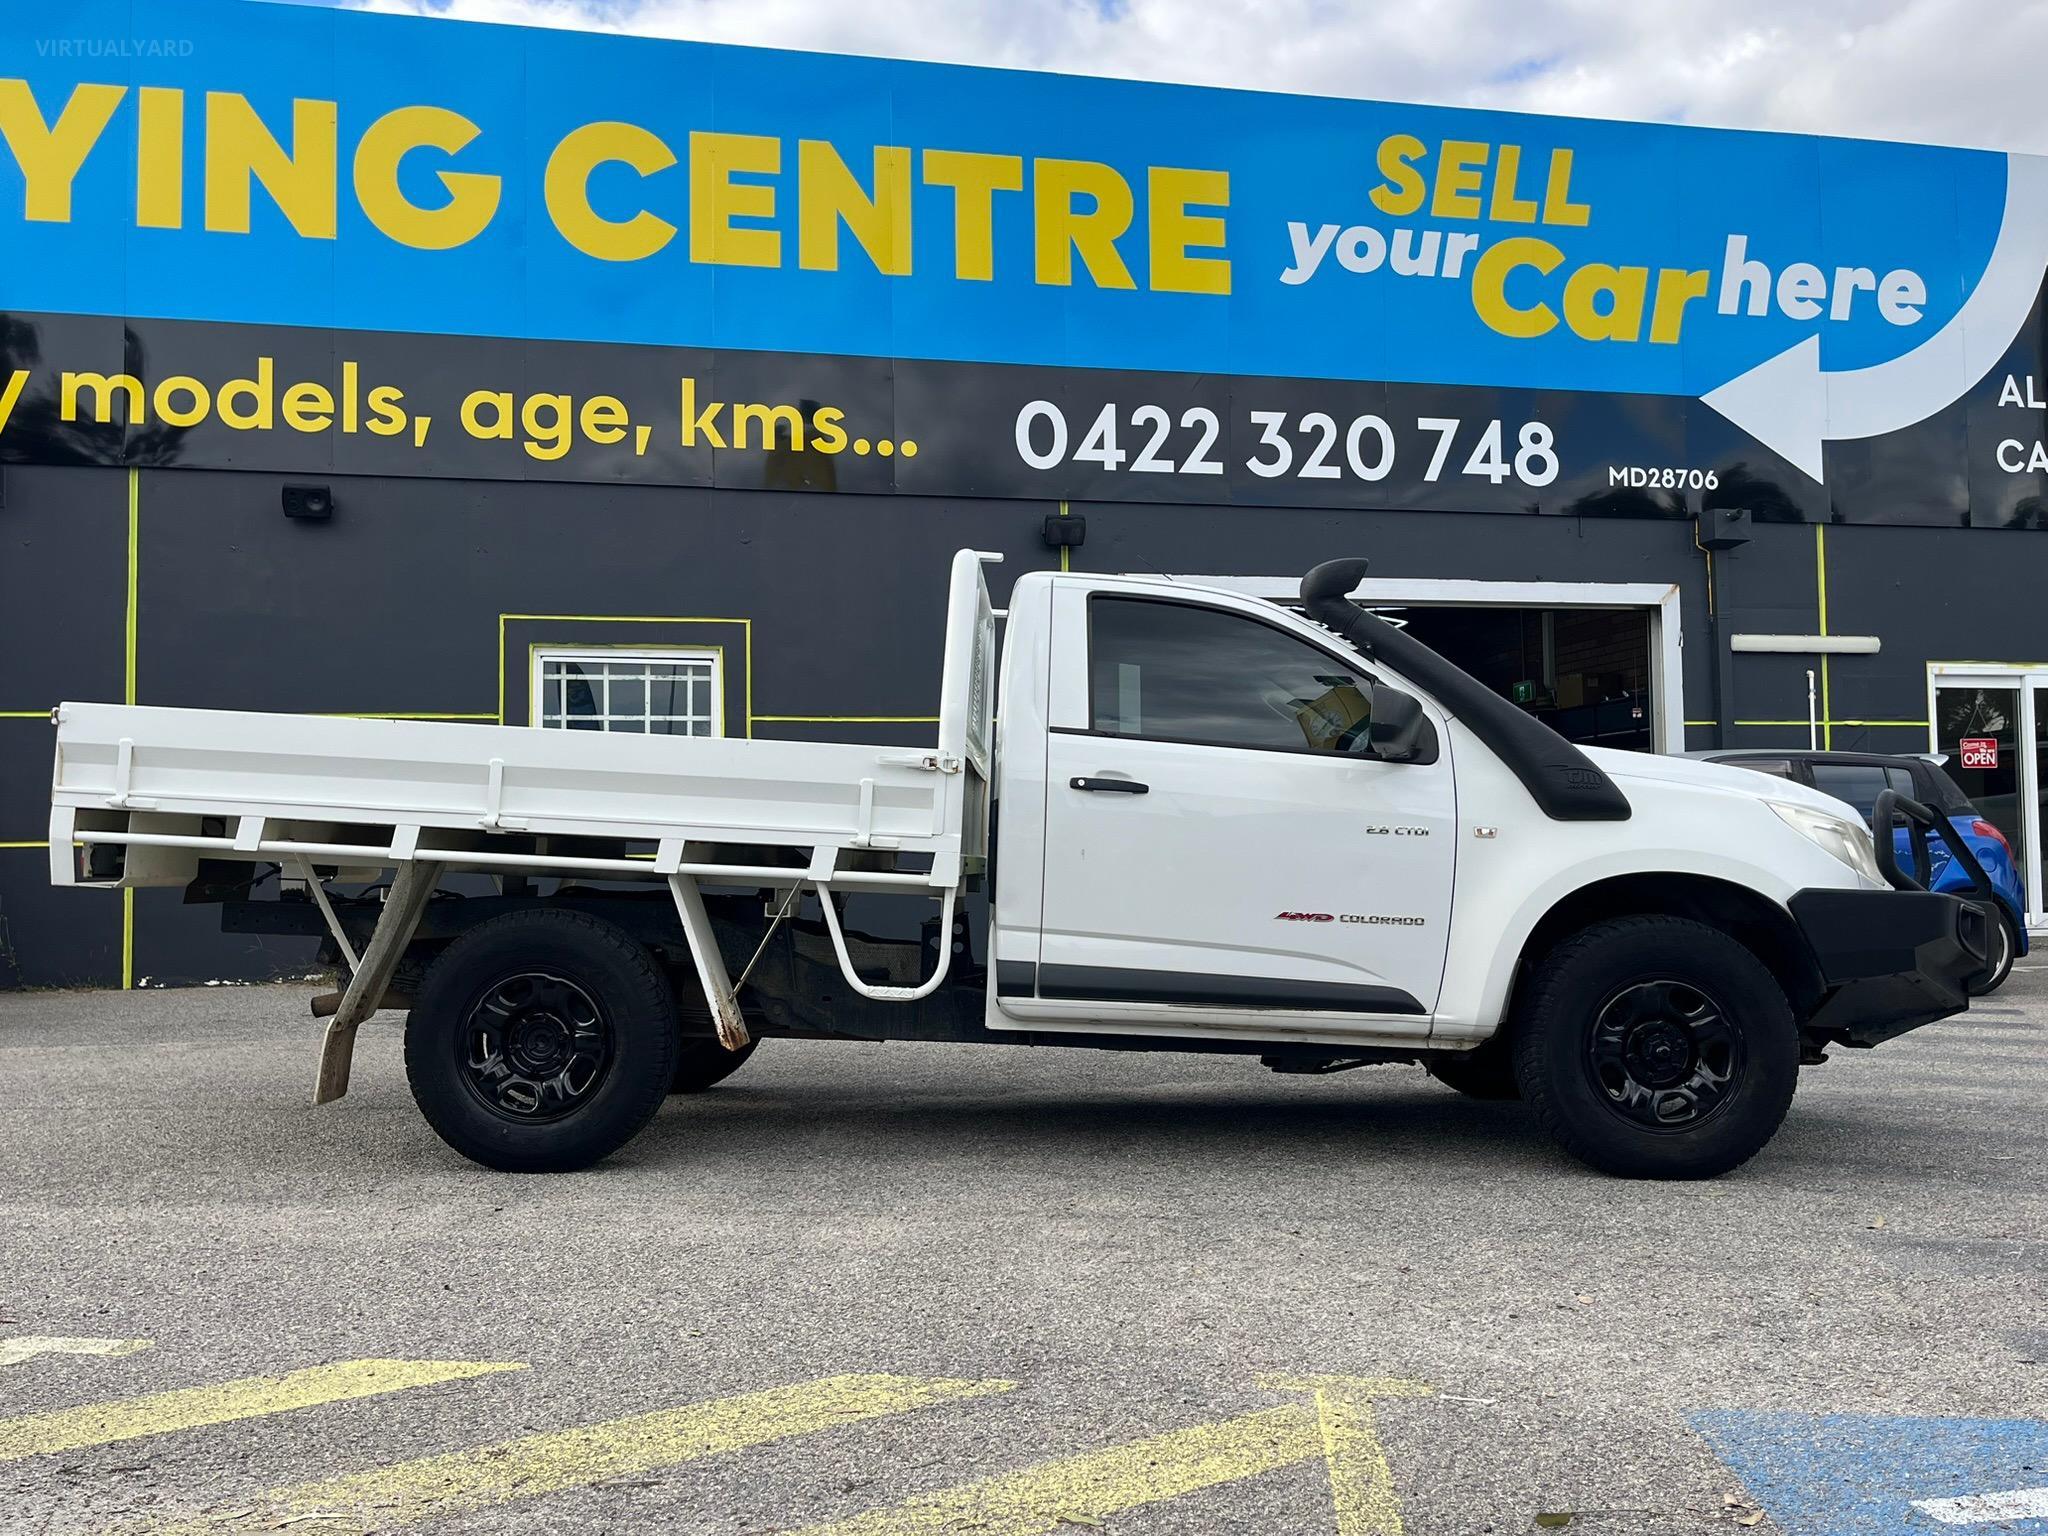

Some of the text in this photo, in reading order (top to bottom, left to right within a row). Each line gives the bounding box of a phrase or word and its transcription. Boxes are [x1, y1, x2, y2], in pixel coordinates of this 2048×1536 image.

[0, 78, 1232, 296] YING CENTRE
[1369, 134, 1592, 228] SELL
[1280, 221, 1927, 345] your Car here
[60, 356, 432, 448] models,
[460, 389, 652, 461] age,
[681, 377, 918, 458] kms...
[1997, 373, 2047, 409] AL
[1015, 399, 1560, 487] 0422 320 748
[1996, 438, 2048, 474] CA
[1608, 465, 1719, 490] MD28706
[1963, 752, 1996, 765] OPEN
[1339, 913, 1425, 926] COLORADO
